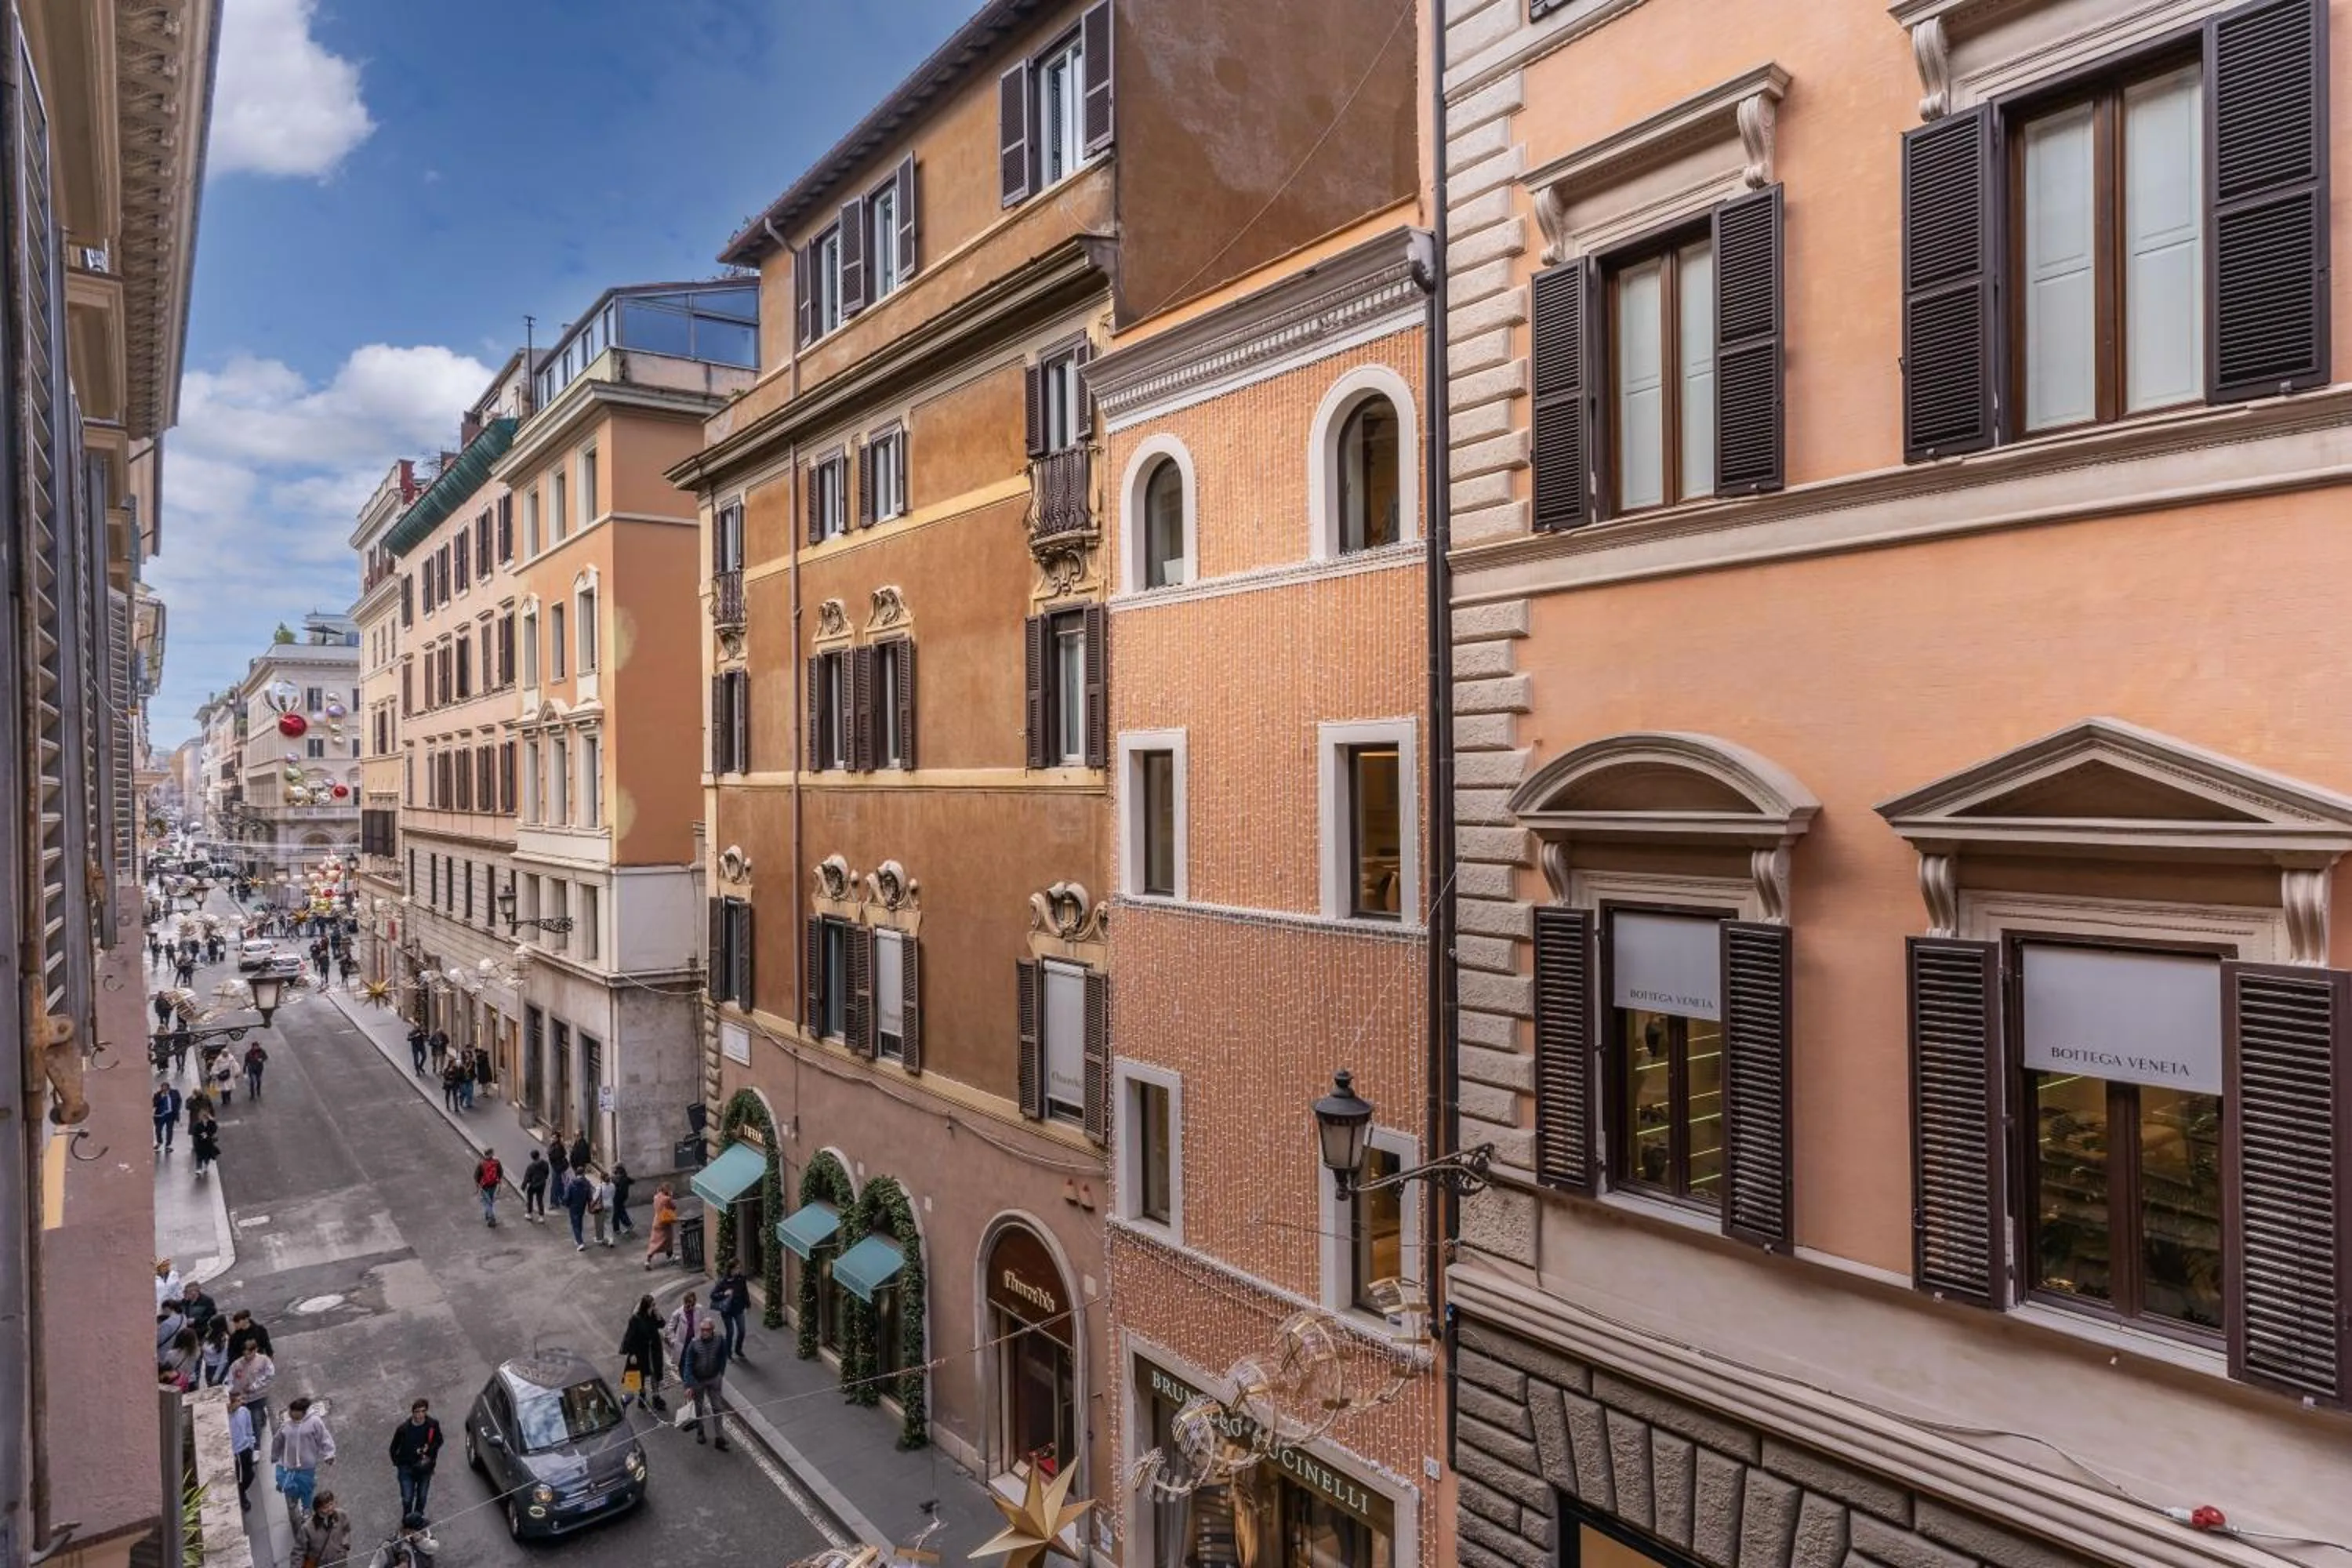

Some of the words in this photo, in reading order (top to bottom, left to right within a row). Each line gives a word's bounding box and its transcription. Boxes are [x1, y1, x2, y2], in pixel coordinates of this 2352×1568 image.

[1630, 989, 1672, 1004] BOTTEGA
[1675, 996, 1714, 1009] VENETA
[2051, 1047, 2123, 1067] BOTTEGA
[2125, 1056, 2190, 1077] VENETA
